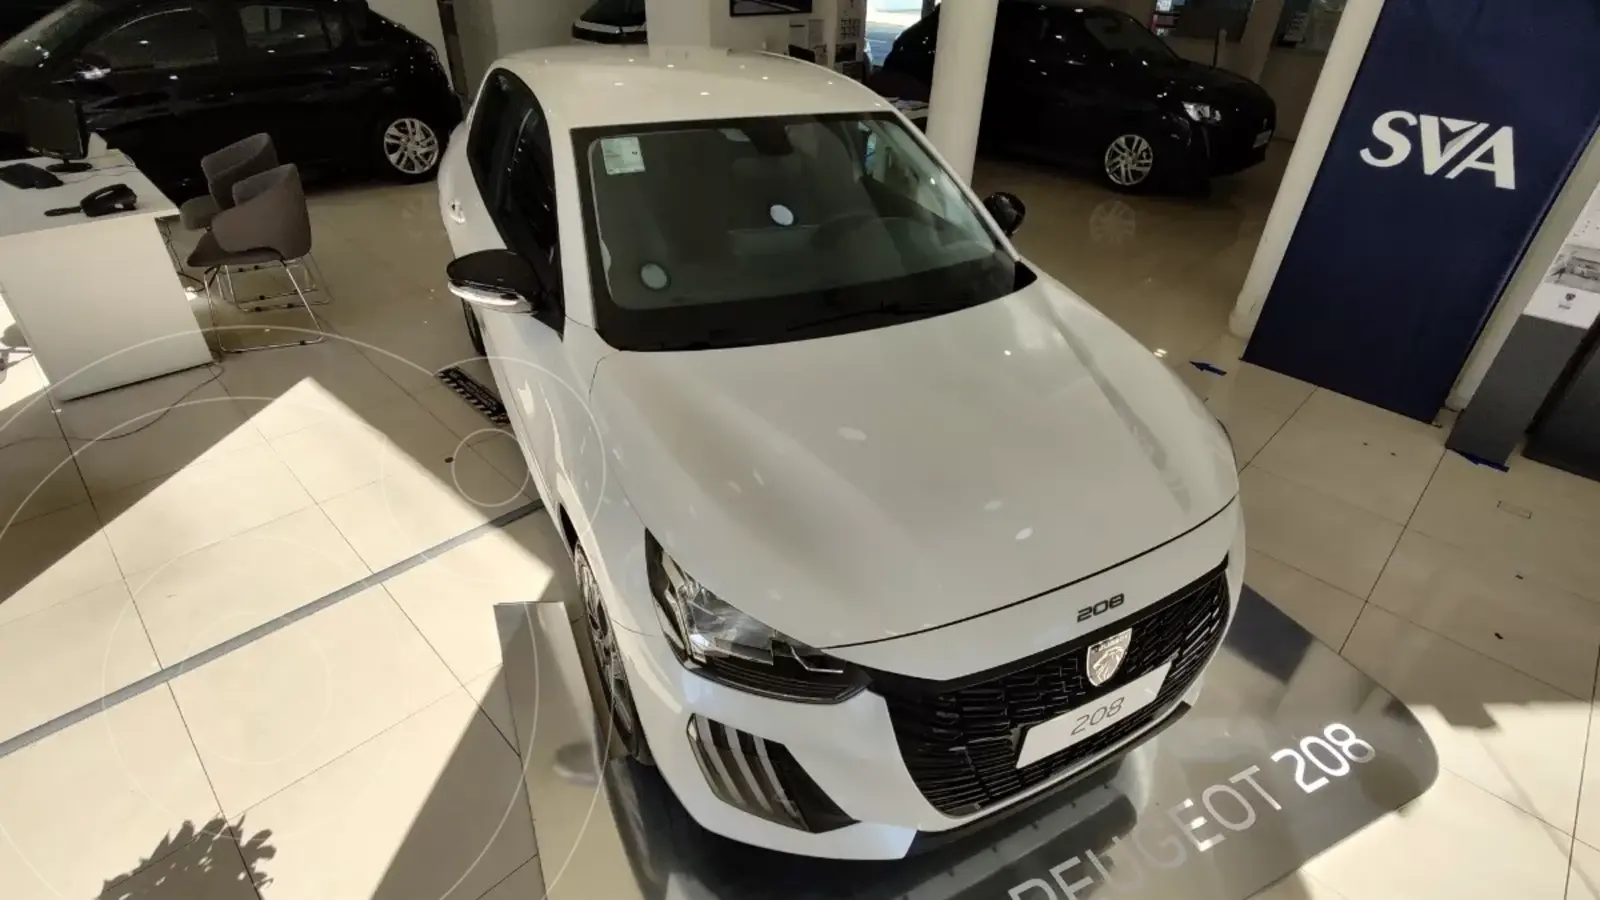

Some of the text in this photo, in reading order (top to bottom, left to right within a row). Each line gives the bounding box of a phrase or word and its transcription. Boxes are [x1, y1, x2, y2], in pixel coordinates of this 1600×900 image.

[1360, 110, 1516, 190] SVA
[1077, 593, 1125, 623] 208
[1070, 696, 1125, 736] 208
[1270, 723, 1376, 794] 208
